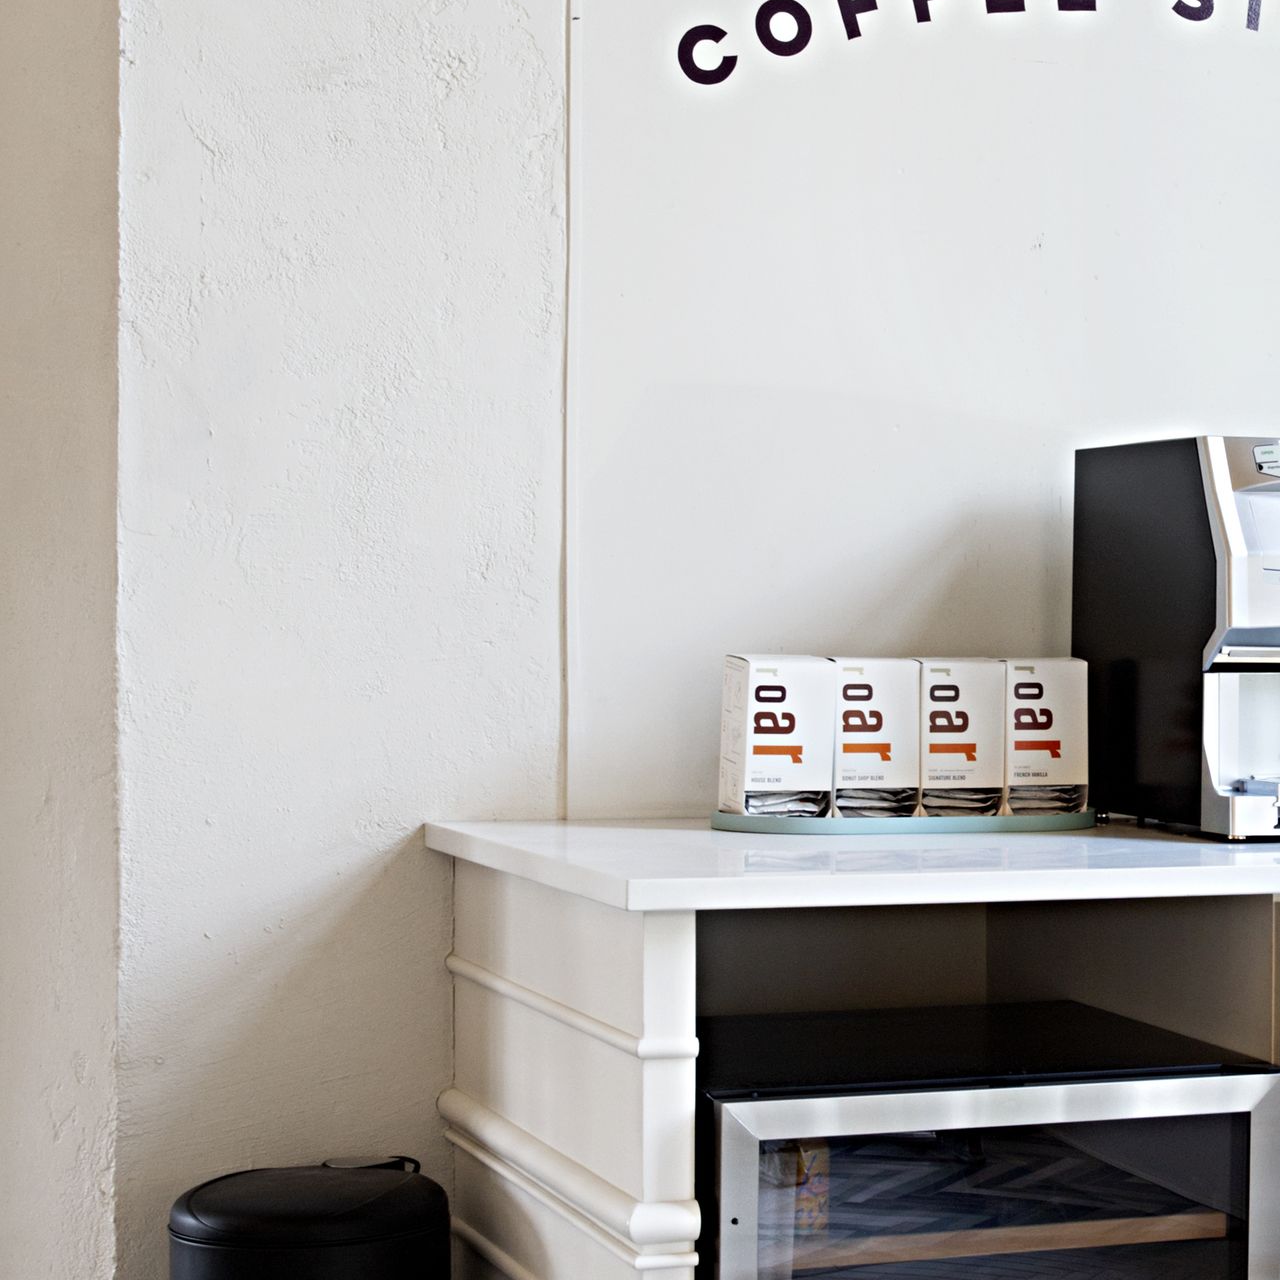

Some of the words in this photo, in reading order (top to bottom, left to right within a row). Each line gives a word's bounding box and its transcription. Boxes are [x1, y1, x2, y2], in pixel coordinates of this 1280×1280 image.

[752, 668, 803, 764] roar
[842, 666, 892, 762] roar
[929, 668, 977, 762] roar
[1013, 665, 1062, 759] roar
